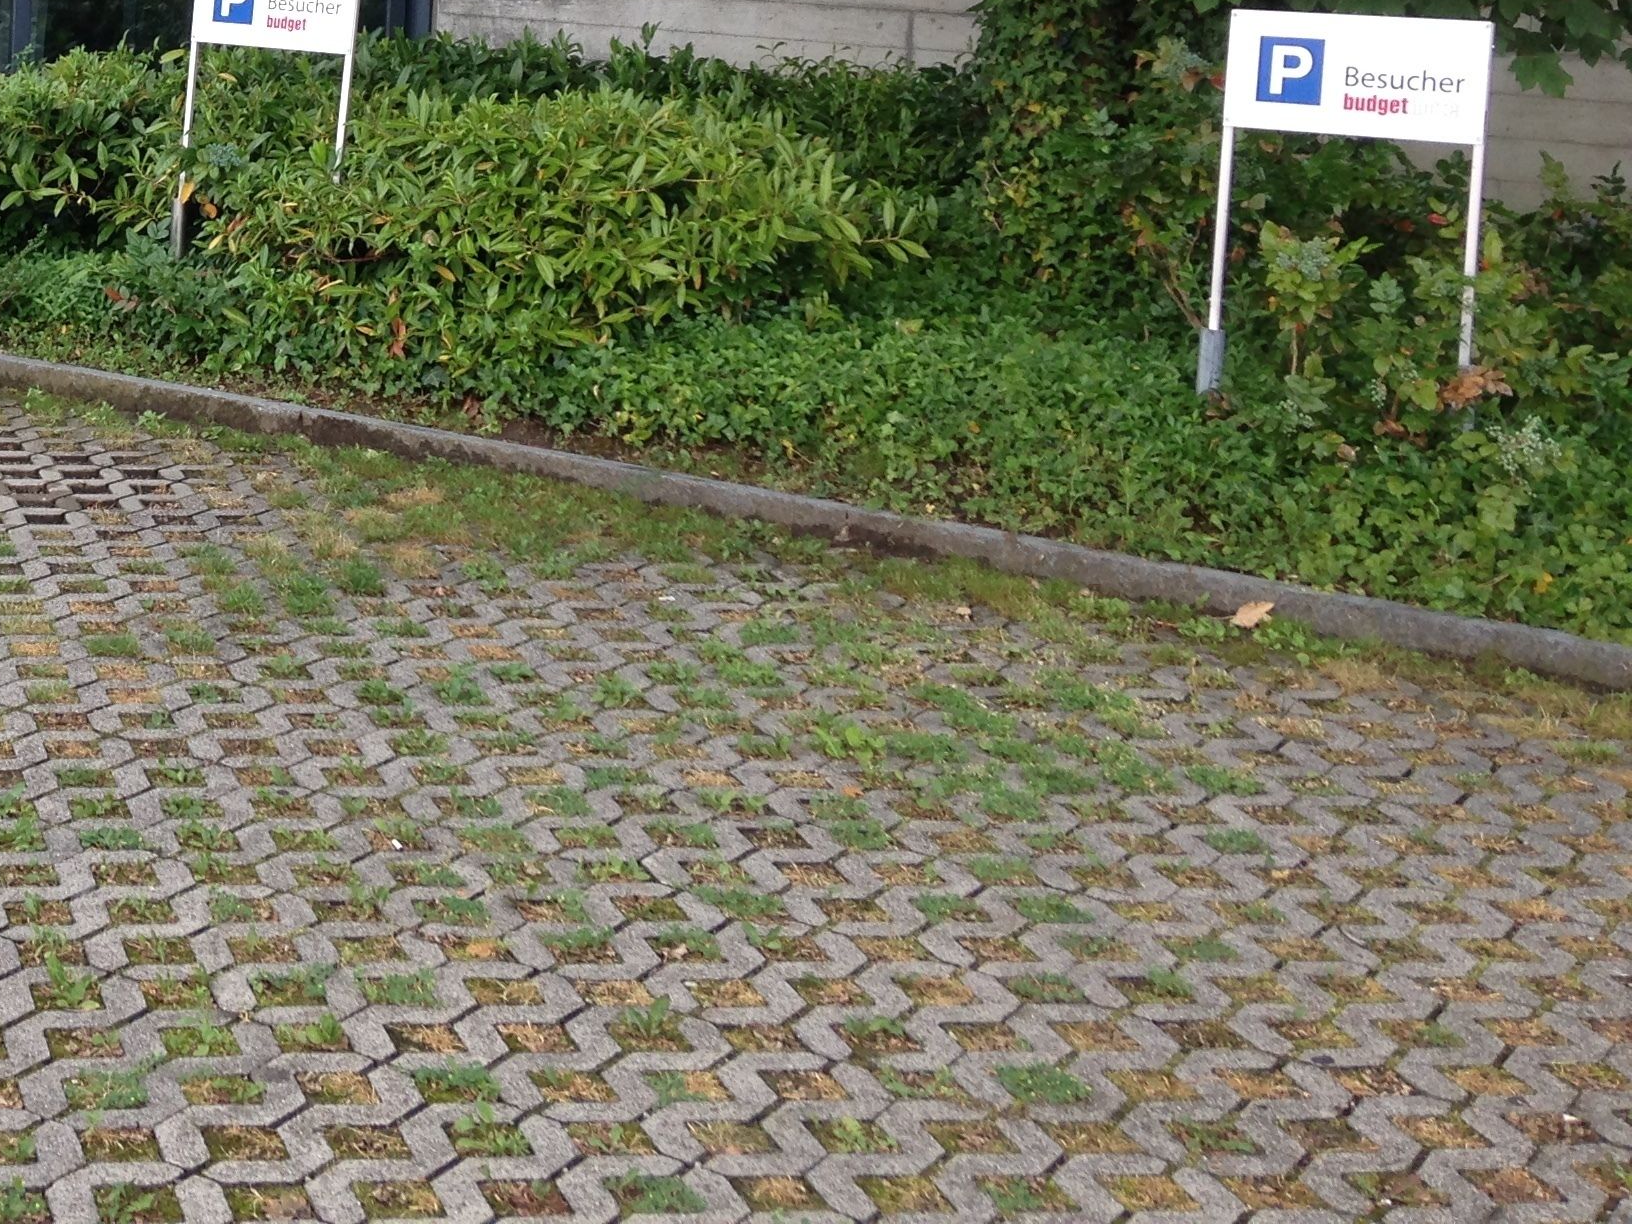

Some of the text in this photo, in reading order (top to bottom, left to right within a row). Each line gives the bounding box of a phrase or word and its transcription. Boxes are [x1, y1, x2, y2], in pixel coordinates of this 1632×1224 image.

[266, 14, 307, 33] budget
[1269, 44, 1466, 95] P Besucher
[1342, 92, 1410, 117] budget
